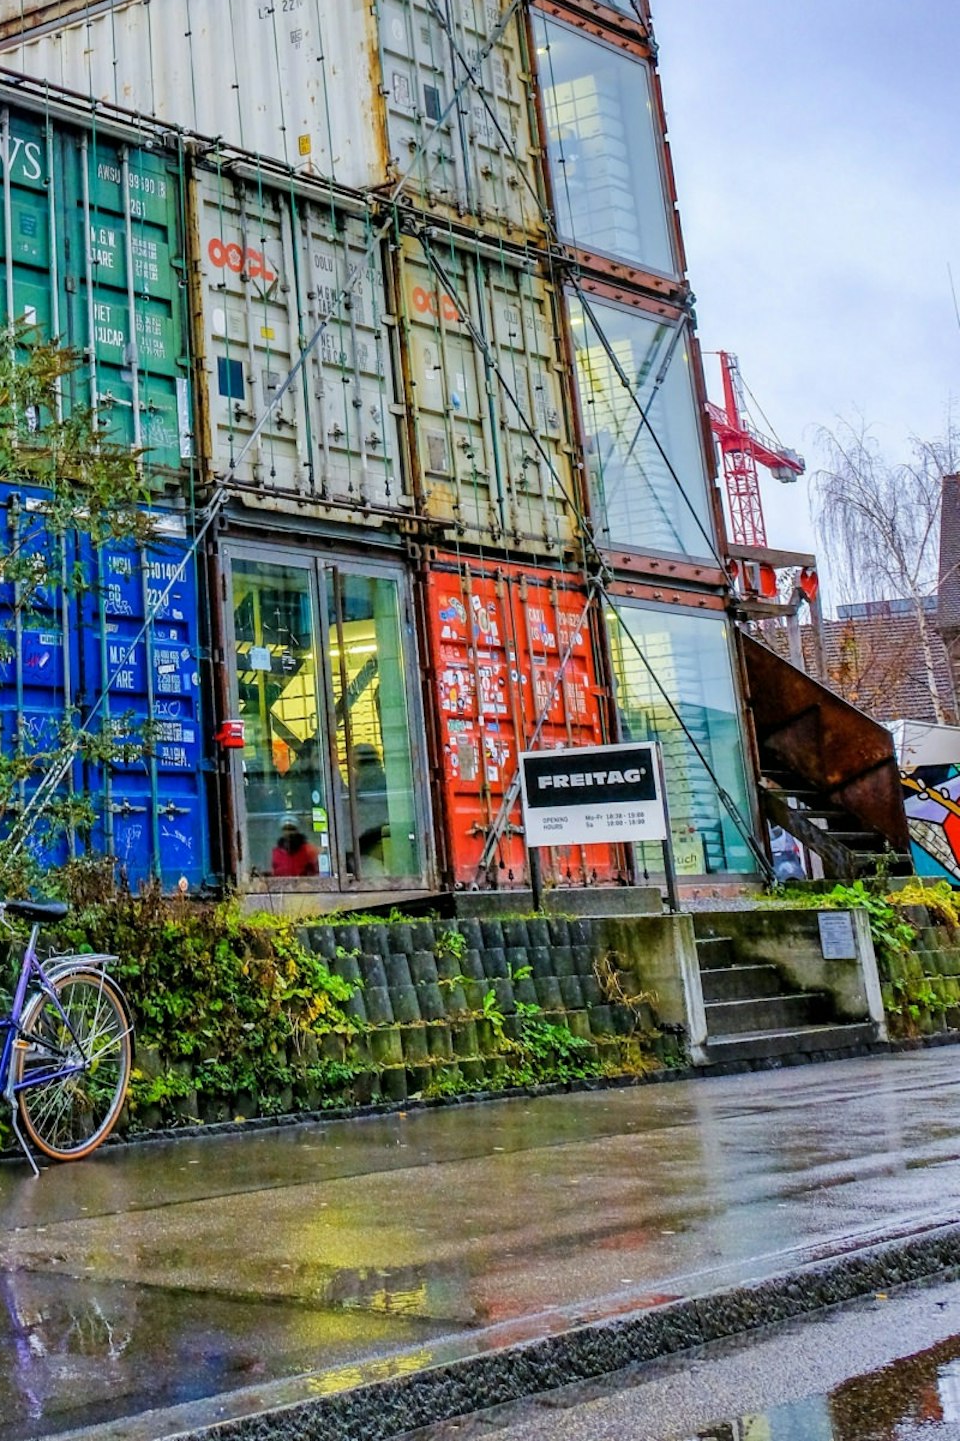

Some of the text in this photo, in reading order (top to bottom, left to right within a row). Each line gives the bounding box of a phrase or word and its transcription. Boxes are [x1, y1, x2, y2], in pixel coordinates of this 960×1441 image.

[97, 163, 120, 184] AWSU
[208, 238, 275, 282] OOCL
[94, 303, 111, 323] NET
